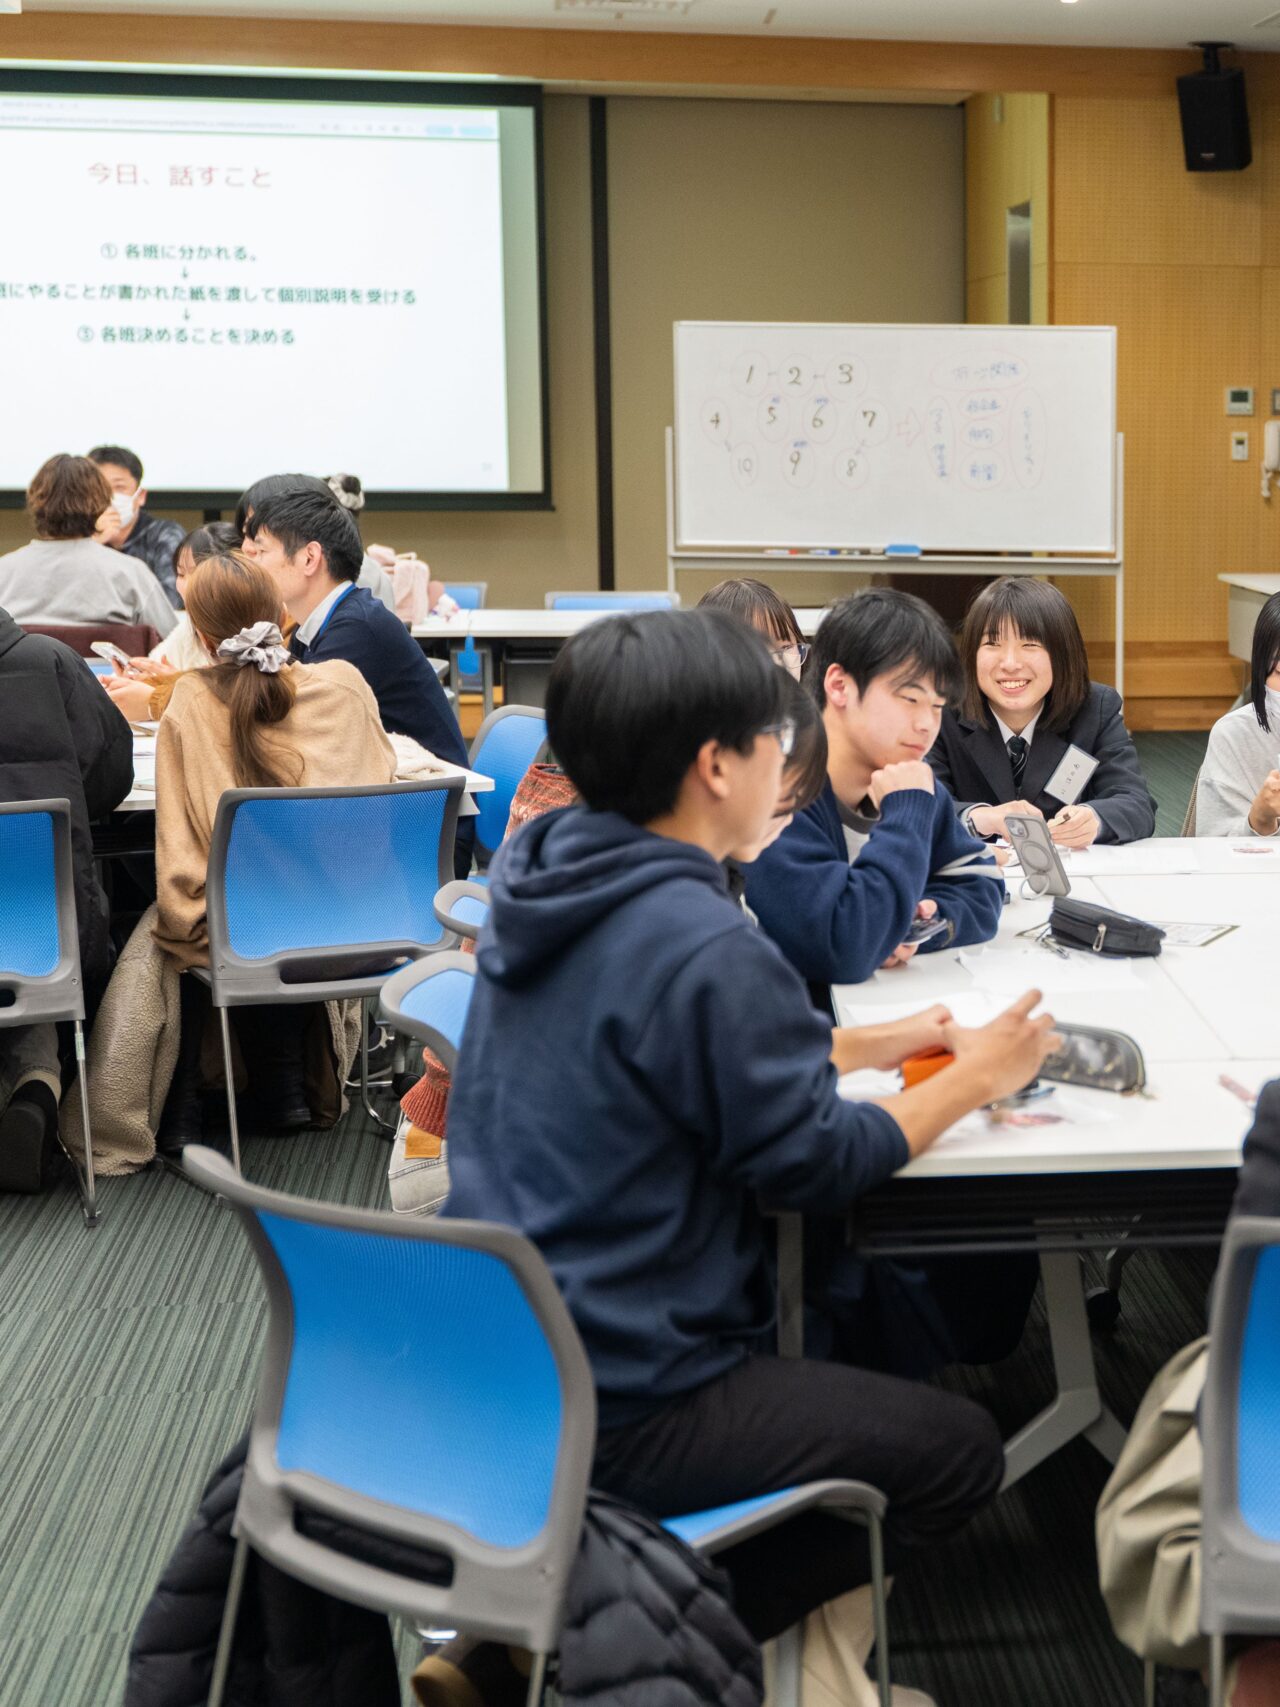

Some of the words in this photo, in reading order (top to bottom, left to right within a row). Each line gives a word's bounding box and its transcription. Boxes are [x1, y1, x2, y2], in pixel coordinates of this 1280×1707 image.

[126, 243, 257, 262] 各班に分かれる。
[102, 326, 296, 345] 各班決めることを決める
[788, 366, 802, 386] 2
[838, 363, 853, 384] 3
[709, 411, 721, 430] 4
[766, 405, 777, 426] 5
[811, 403, 825, 429] 6
[862, 409, 877, 428] 7
[789, 450, 801, 476] 9
[846, 458, 857, 477] 8
